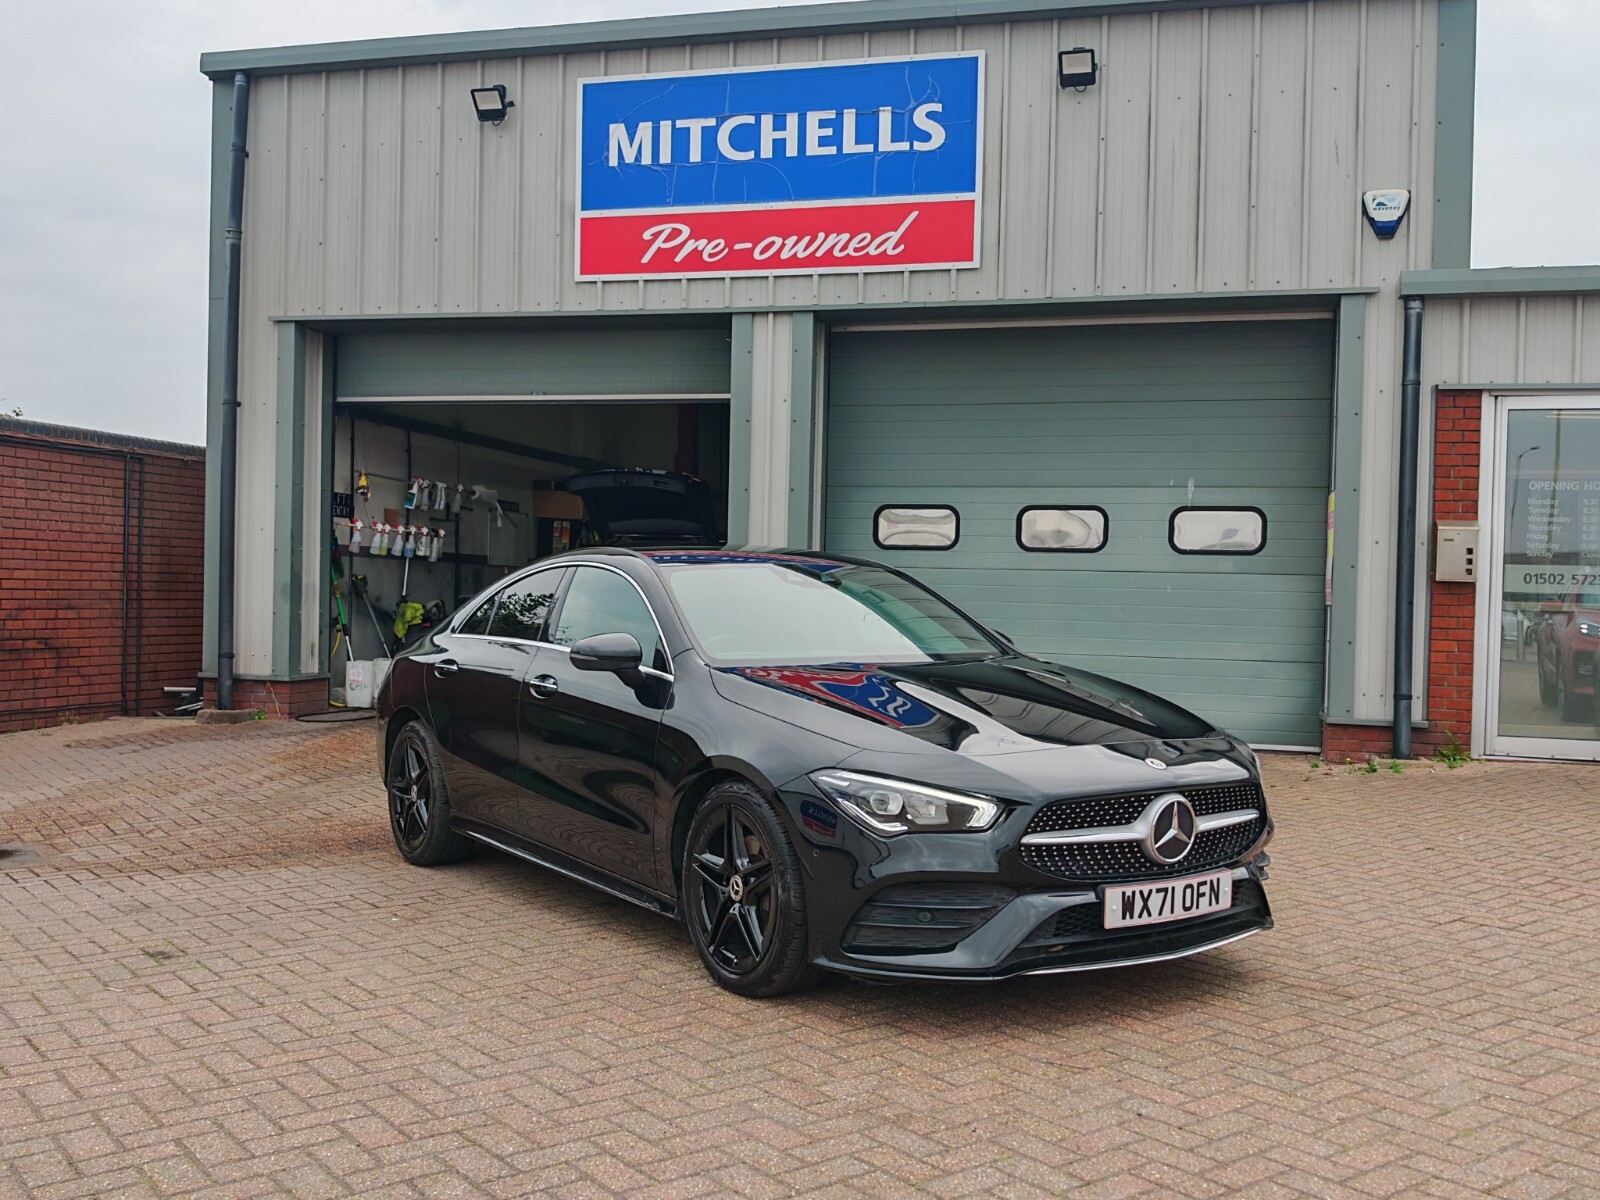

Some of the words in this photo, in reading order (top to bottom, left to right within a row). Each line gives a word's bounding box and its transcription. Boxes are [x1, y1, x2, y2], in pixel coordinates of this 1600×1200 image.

[608, 103, 946, 167] MITCHELLS
[641, 210, 919, 264] Pre-owned
[1528, 481, 1579, 490] OPENING
[1527, 498, 1558, 506] Monday
[1527, 507, 1558, 515] Tuesday
[1527, 515, 1571, 524] Wednesday
[1528, 524, 1561, 532] Thursday
[1526, 533, 1549, 541] Friday
[1526, 542, 1560, 550] Saturday
[1526, 551, 1553, 559] Sunday
[1523, 573, 1565, 585] 01502
[1121, 886, 1176, 920] WX71
[1182, 877, 1220, 912] OFN
